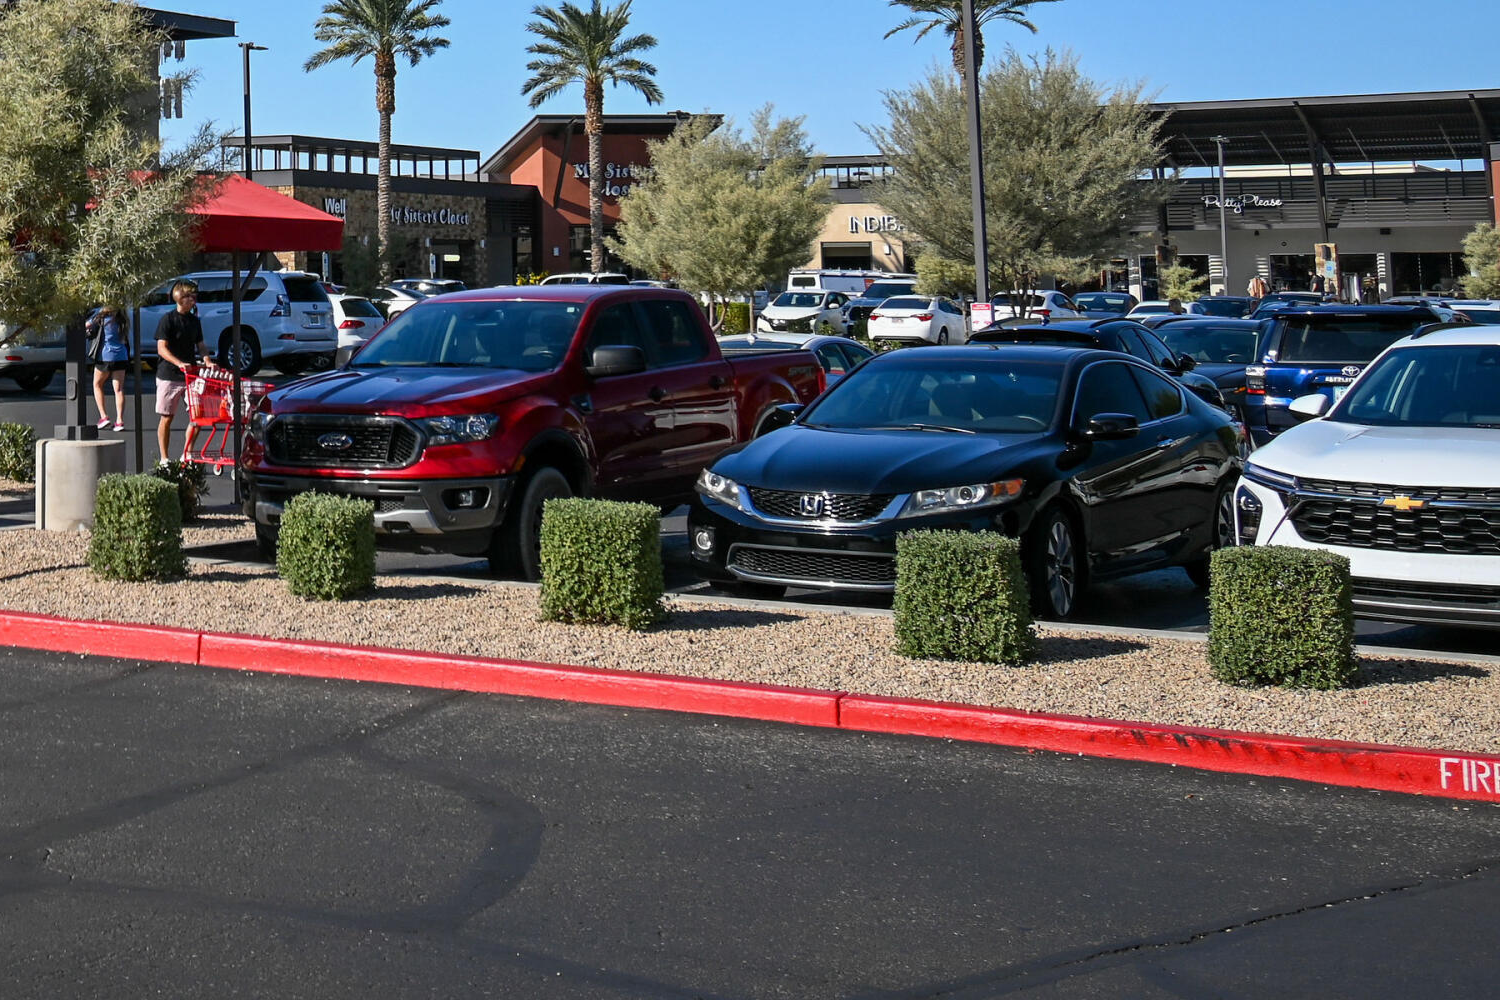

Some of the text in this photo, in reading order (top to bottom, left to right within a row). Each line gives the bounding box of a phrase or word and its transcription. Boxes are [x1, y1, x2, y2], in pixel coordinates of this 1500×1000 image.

[325, 198, 346, 213] Well
[1238, 193, 1282, 208] Please
[404, 206, 437, 224] Sister's
[440, 208, 469, 225] Closet
